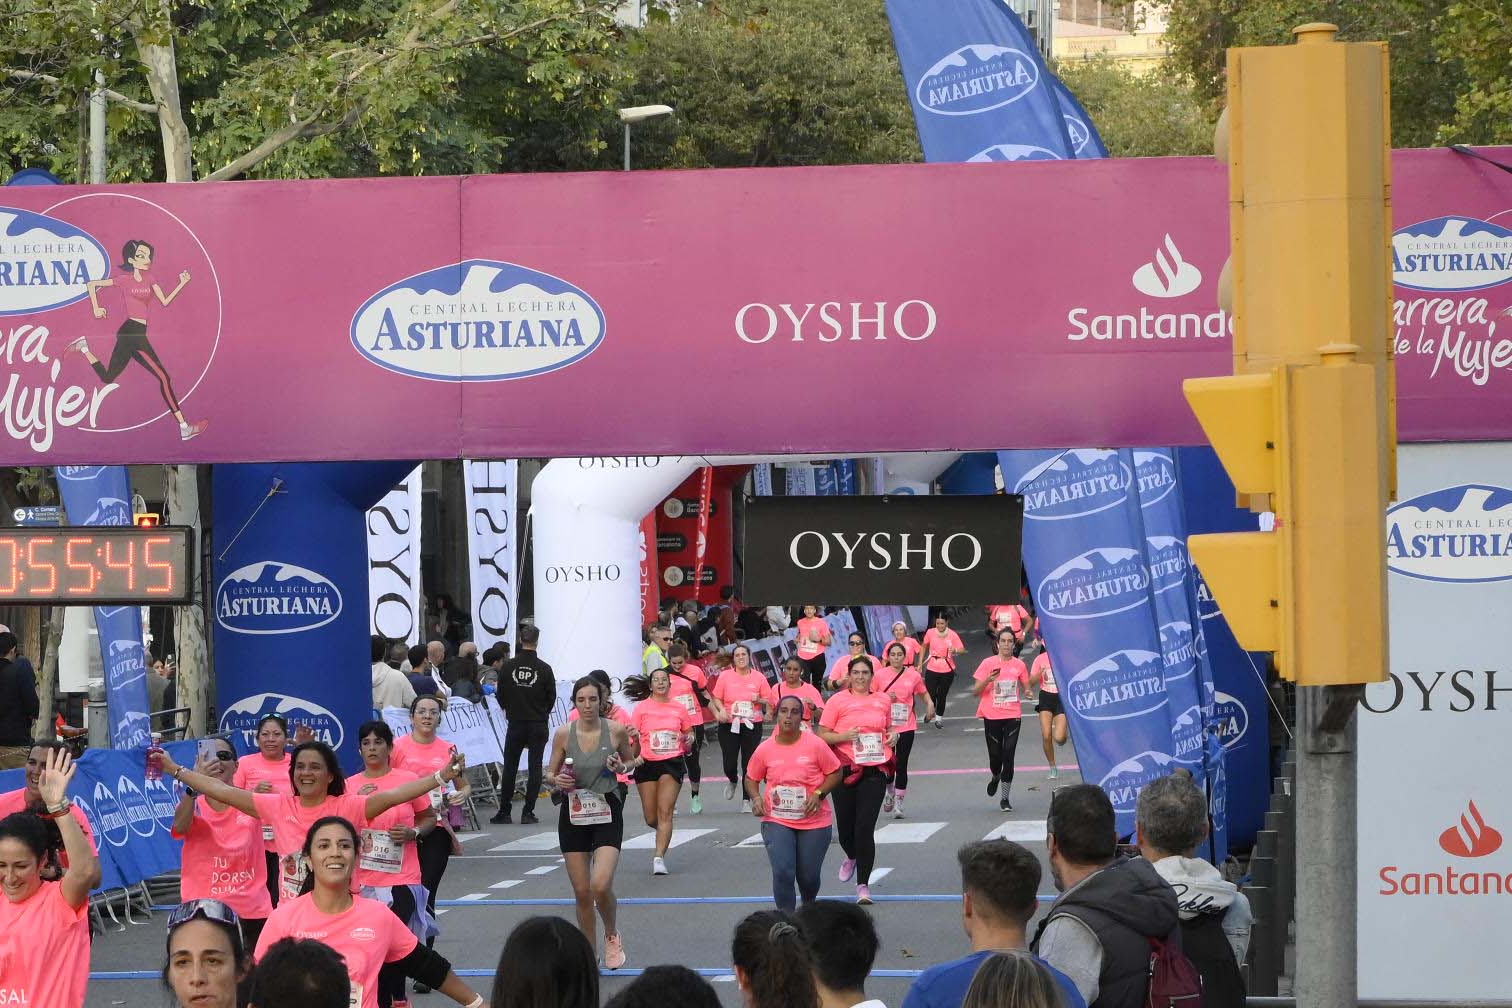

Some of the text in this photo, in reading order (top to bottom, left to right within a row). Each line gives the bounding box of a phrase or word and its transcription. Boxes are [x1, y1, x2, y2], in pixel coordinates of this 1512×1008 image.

[12, 241, 86, 254] LECHERA
[409, 300, 578, 316] CENTRAL LECHERA
[734, 299, 938, 343] OYSHO
[1393, 297, 1489, 326] arrera
[370, 306, 586, 352] ASTURIANA
[1417, 320, 1512, 386] la Muje
[1414, 519, 1481, 529] CENTRAL
[788, 531, 983, 572] OYSHO
[545, 563, 622, 584] OYSHO
[219, 590, 334, 619] ASTURIANA
[232, 585, 276, 595] CENTRAL
[518, 671, 532, 681] BP
[1360, 668, 1512, 714] OYSH
